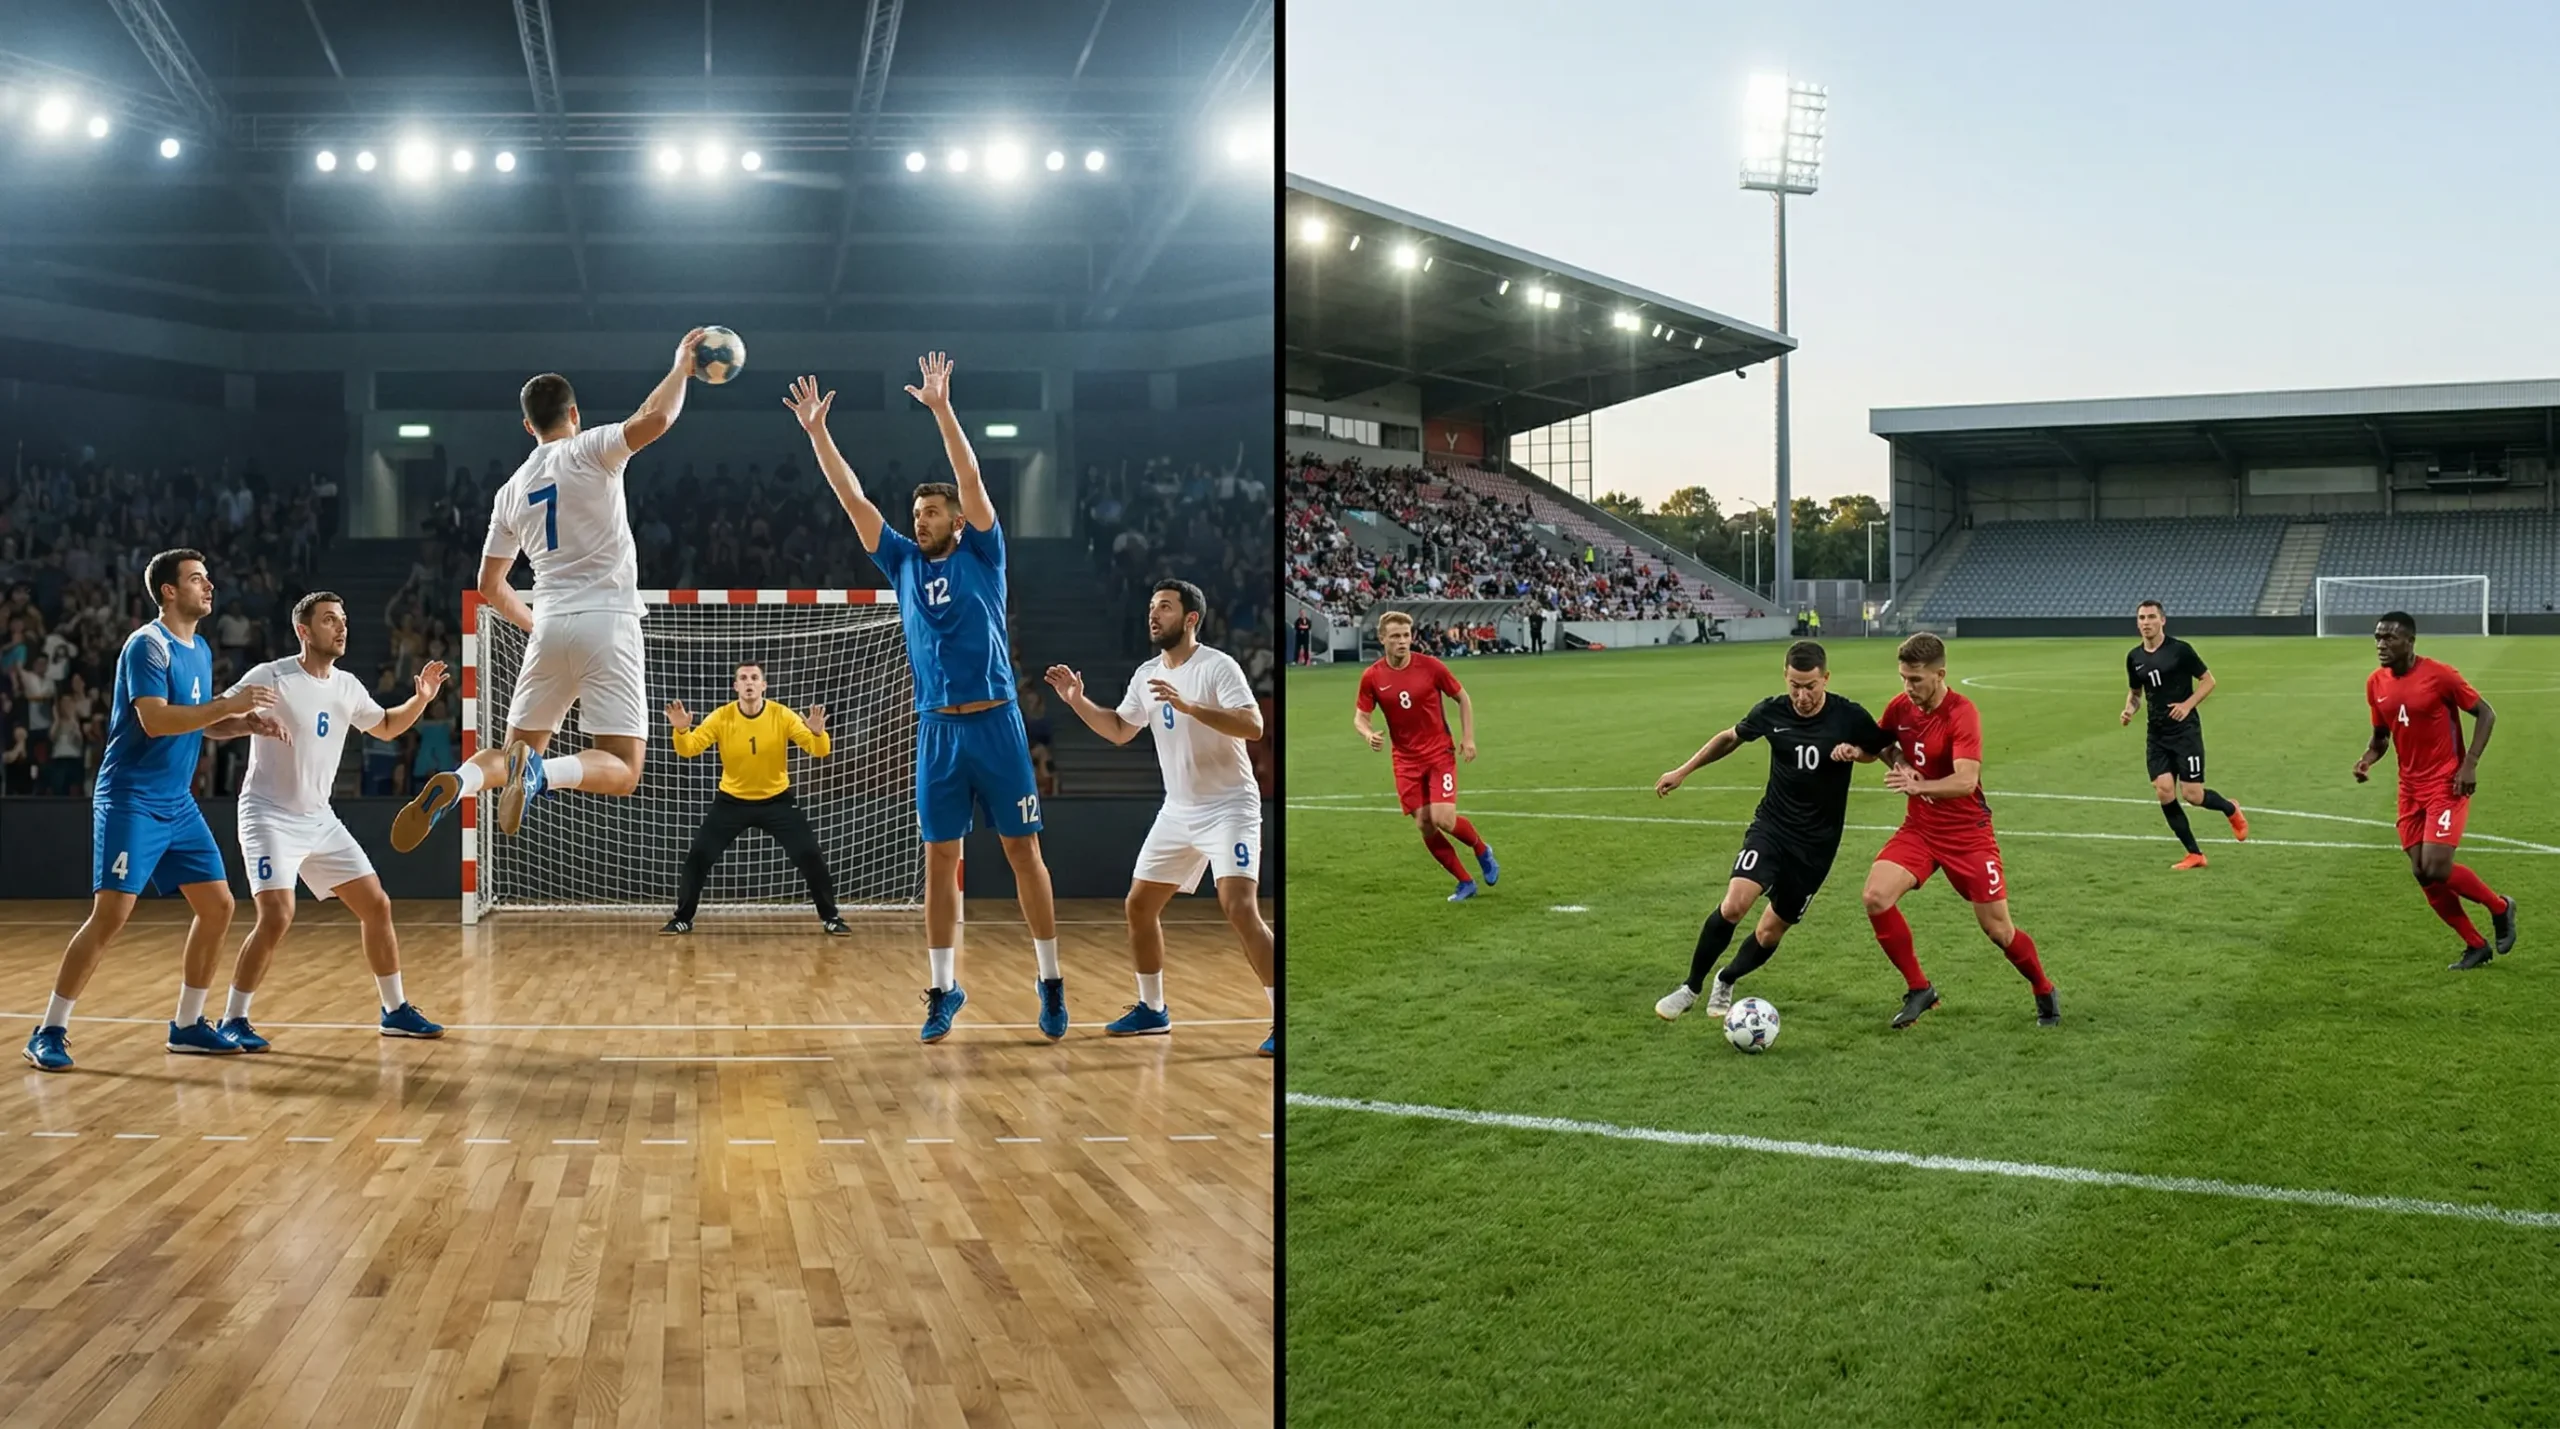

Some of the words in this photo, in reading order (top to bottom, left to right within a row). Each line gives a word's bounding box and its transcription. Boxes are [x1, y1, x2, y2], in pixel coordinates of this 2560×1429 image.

[527, 482, 560, 552] 7
[925, 577, 951, 606] 12
[191, 676, 201, 704] 4
[2148, 669, 2163, 687] 11
[1399, 690, 1412, 709] 8
[317, 711, 329, 738] 6
[1162, 703, 1175, 729] 9
[2398, 704, 2409, 727] 4
[749, 736, 757, 755] 1
[1795, 744, 1820, 770] 10
[1915, 742, 1926, 766] 5
[2187, 756, 2201, 773] 11
[1442, 773, 1454, 791] 8
[1017, 794, 1040, 824] 12
[2438, 809, 2452, 831] 4
[110, 851, 129, 880] 4
[1234, 842, 1250, 867] 9
[1735, 849, 1759, 871] 10
[258, 855, 272, 880] 6
[1985, 860, 2000, 886] 5
